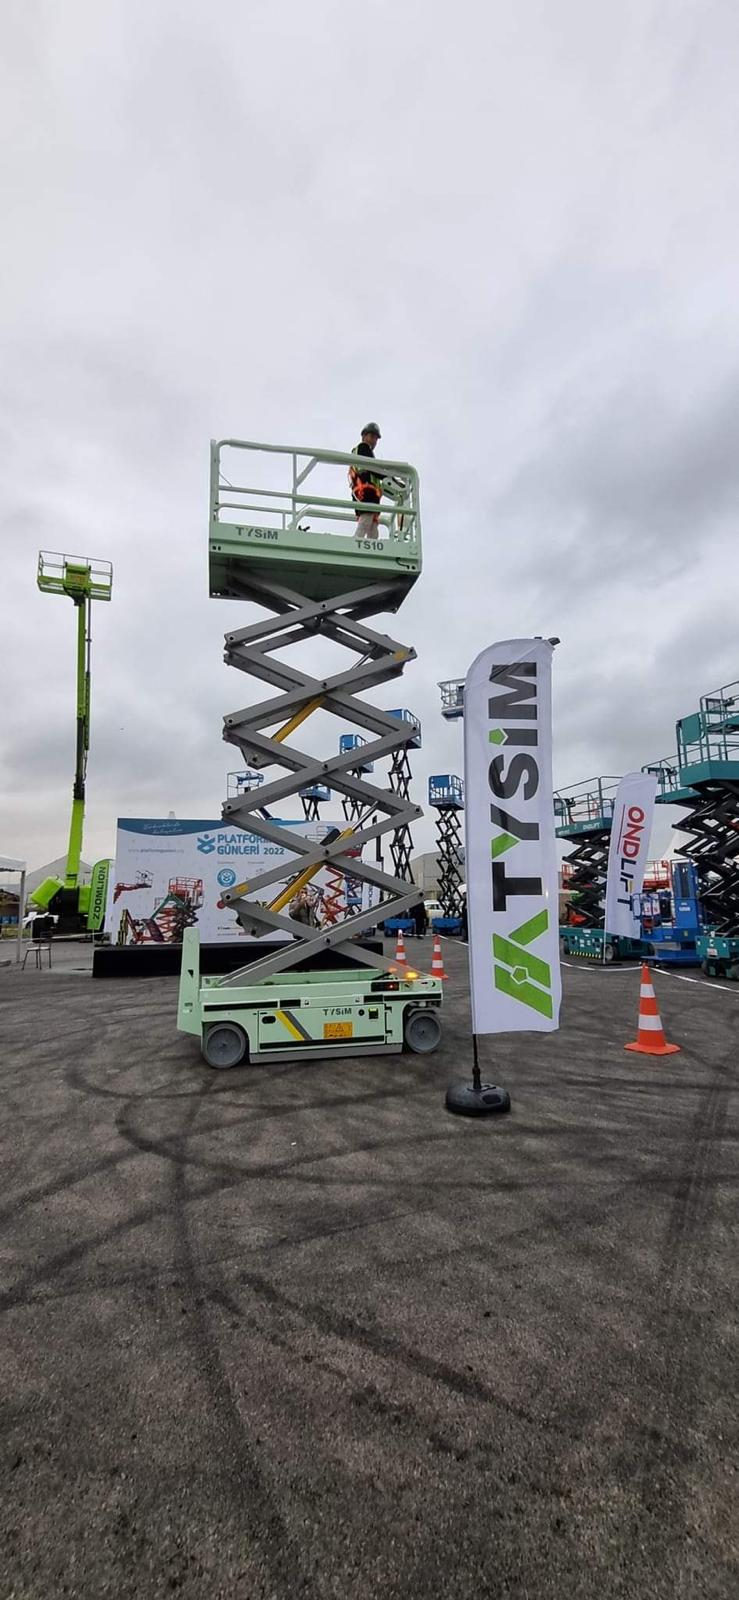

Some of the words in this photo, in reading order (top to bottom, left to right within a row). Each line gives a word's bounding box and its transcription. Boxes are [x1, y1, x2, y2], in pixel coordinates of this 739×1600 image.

[355, 539, 384, 551] TS10
[217, 844, 260, 856] GÜNLERİ
[263, 847, 285, 856] 2022
[92, 866, 107, 920] ZOOMLION
